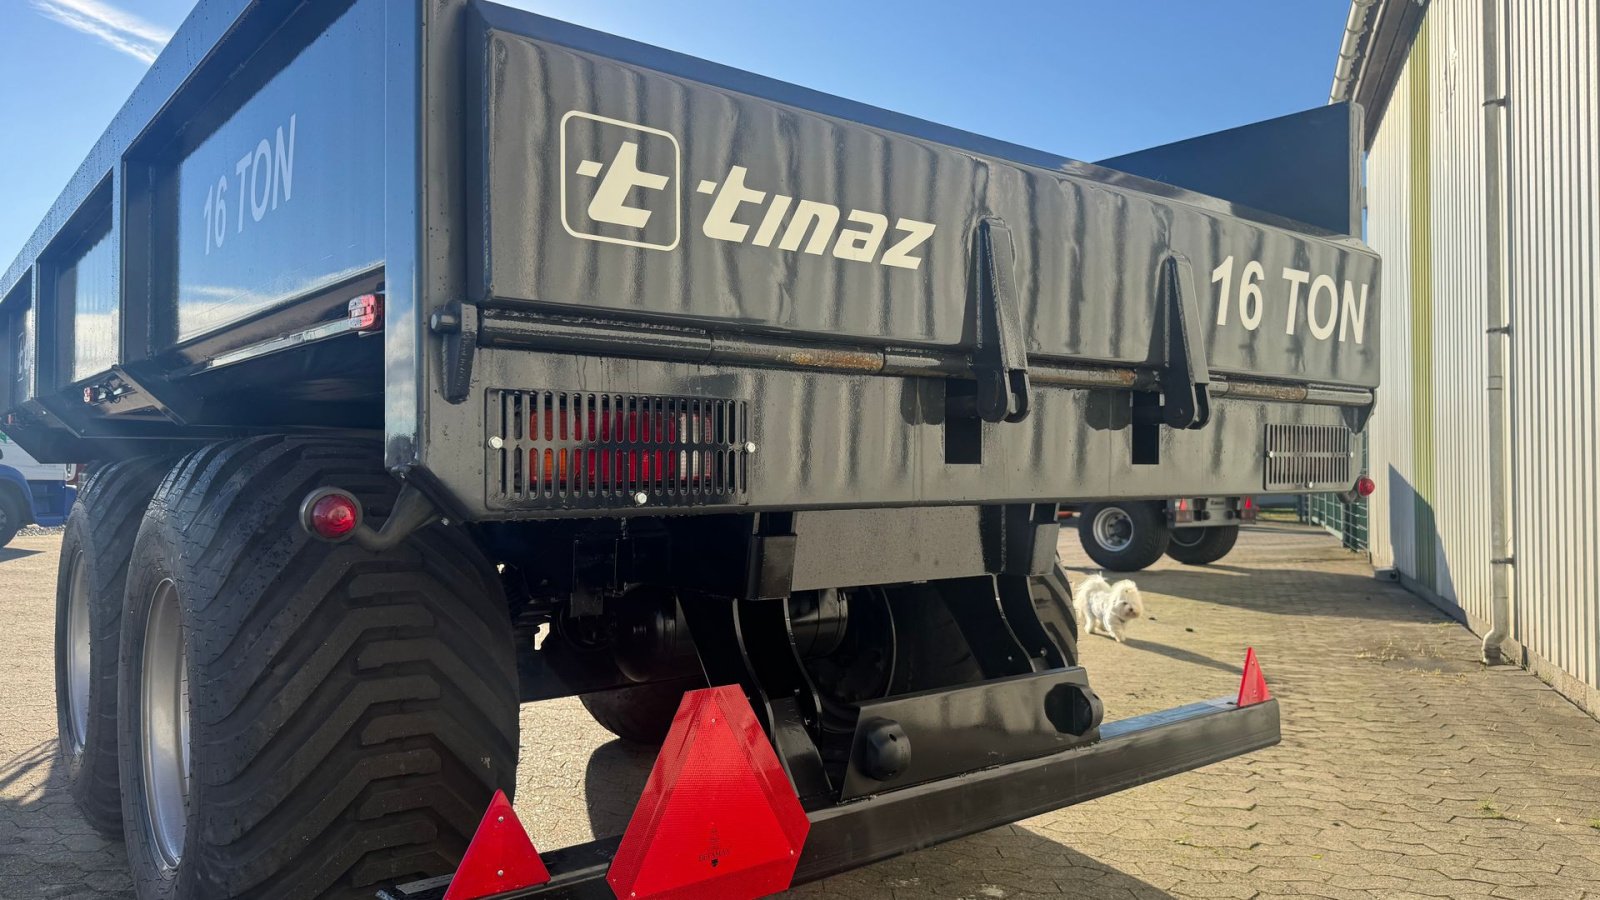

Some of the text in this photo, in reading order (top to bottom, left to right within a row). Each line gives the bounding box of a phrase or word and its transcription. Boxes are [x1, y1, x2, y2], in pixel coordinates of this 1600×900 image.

[204, 112, 296, 256] 16 TON
[1211, 255, 1368, 345] 16 TON
